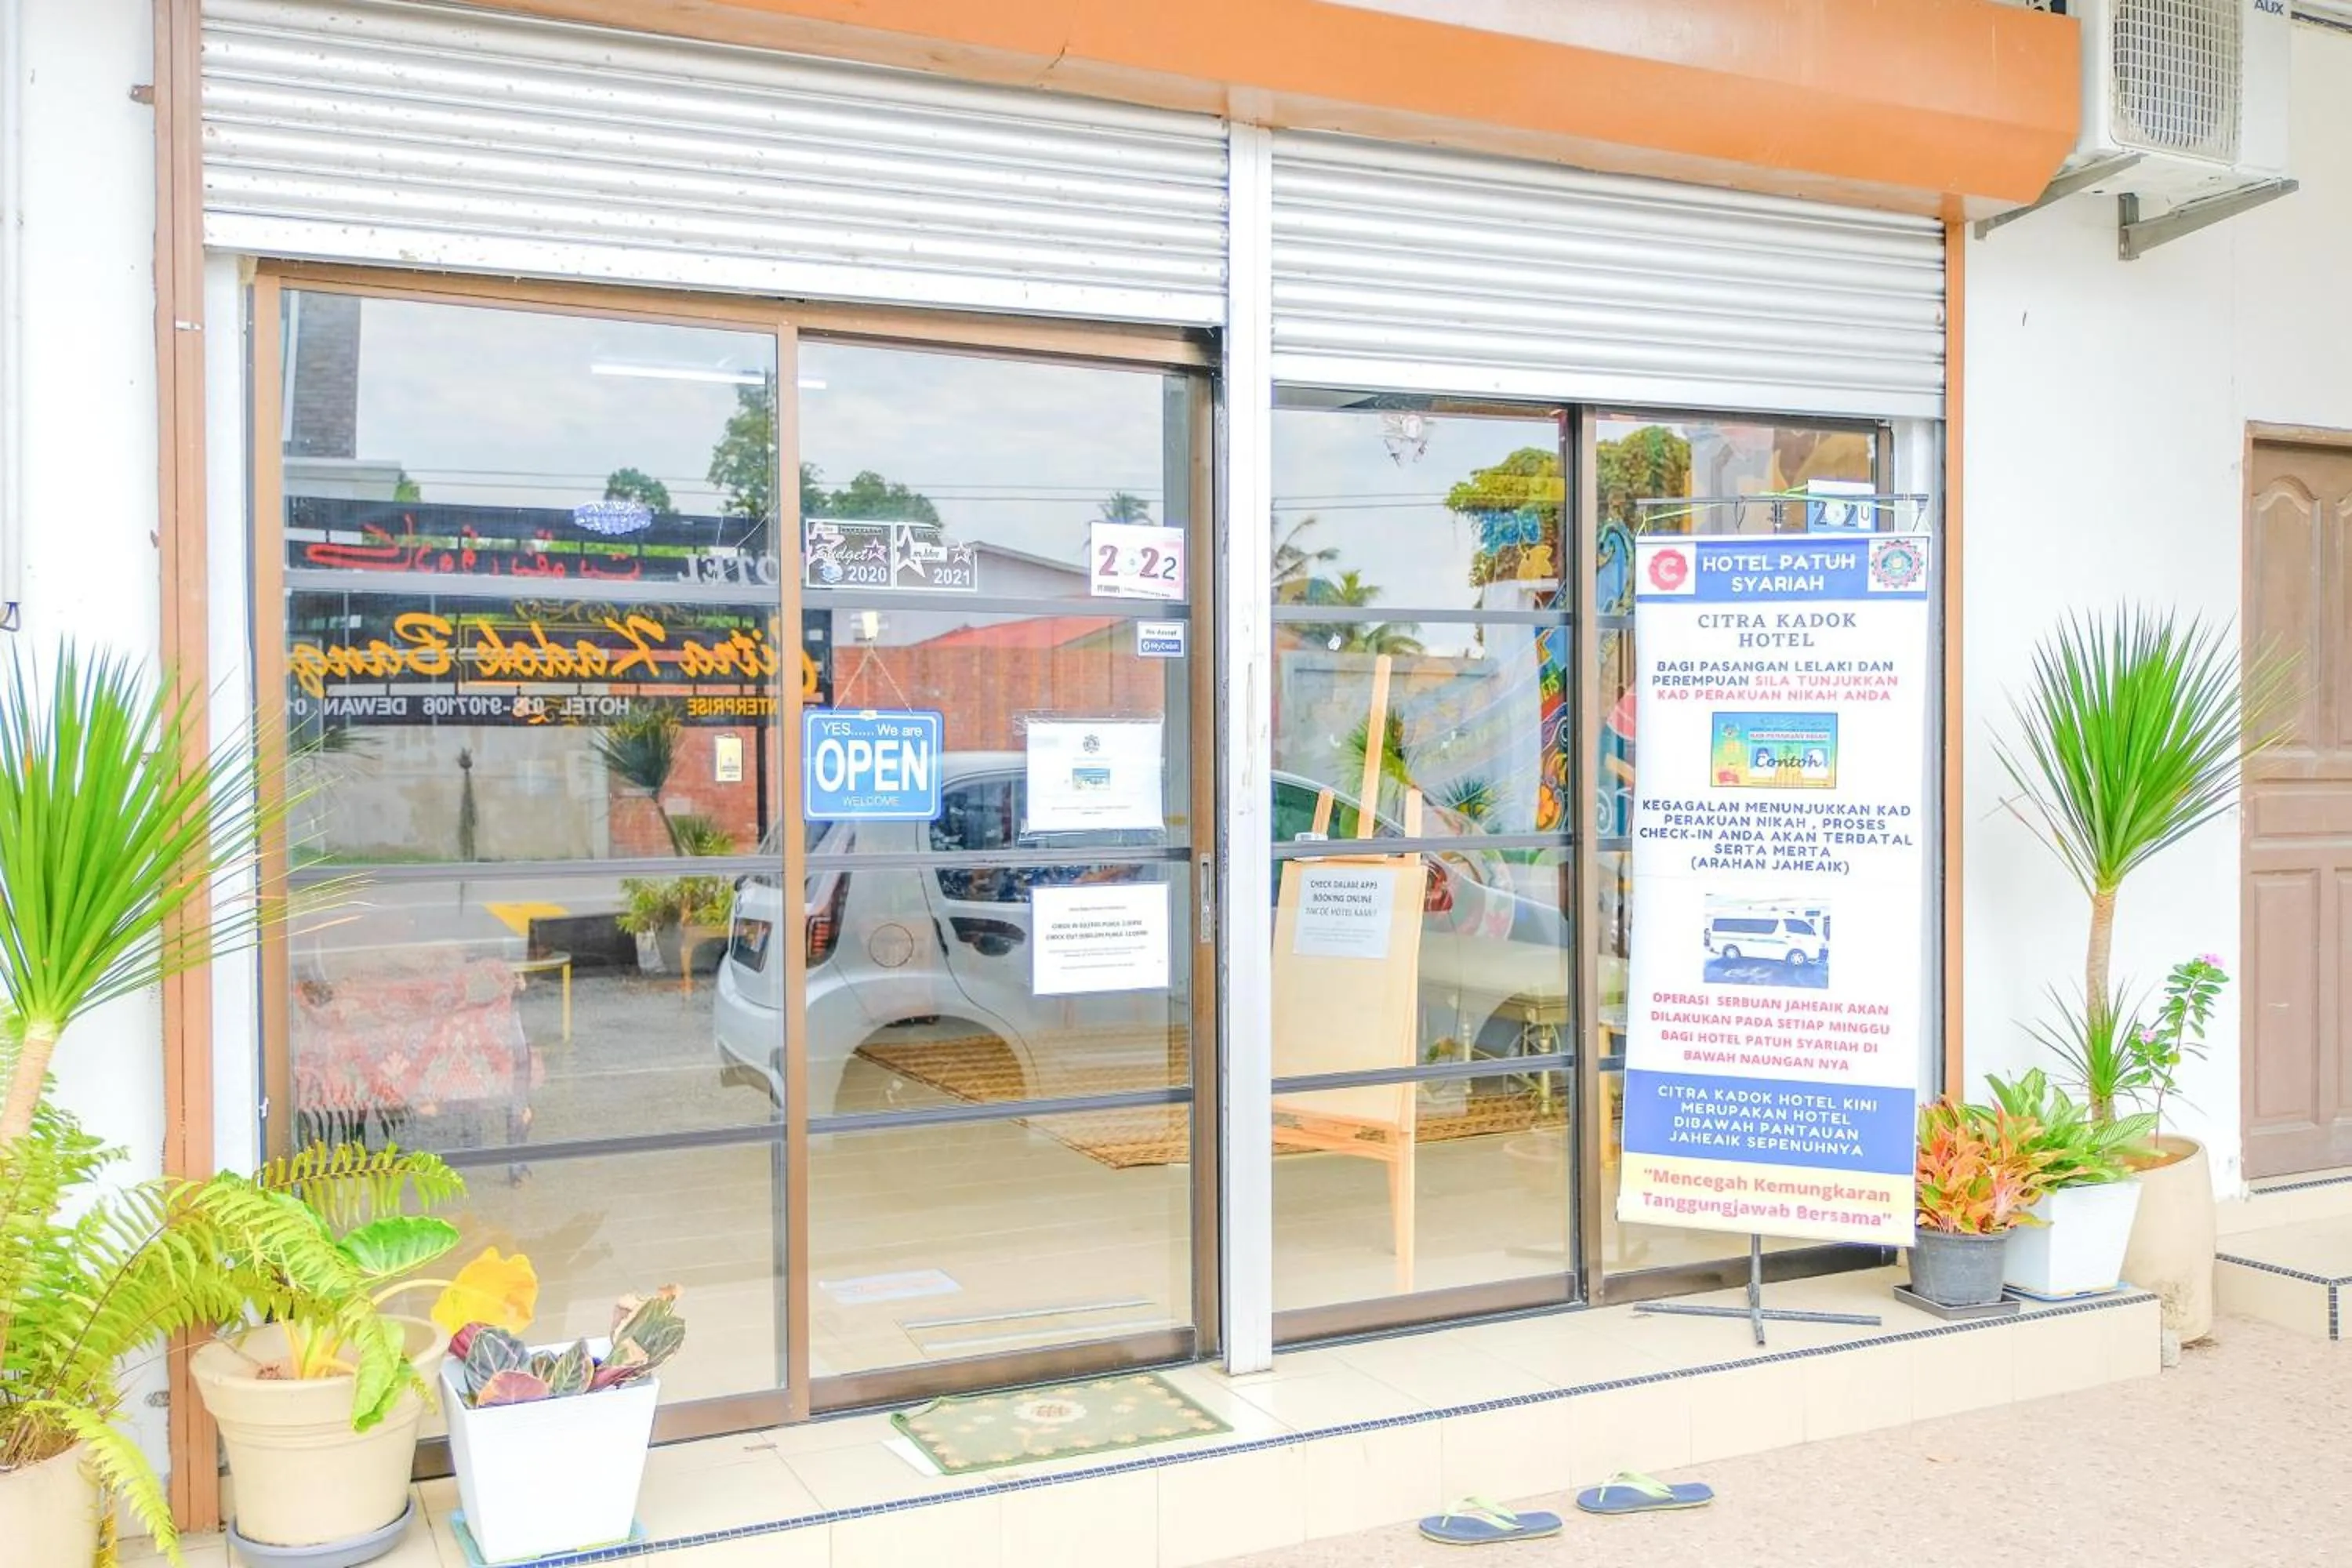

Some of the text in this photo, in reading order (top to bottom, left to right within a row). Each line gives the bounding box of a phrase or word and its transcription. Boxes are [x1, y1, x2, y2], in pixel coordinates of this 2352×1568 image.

[2253, 0, 2284, 15] AUX
[1701, 554, 1856, 572] HOTEL PATUH
[847, 565, 887, 583] 2020
[933, 568, 971, 585] 2021
[1731, 575, 1825, 593] SYARIAH
[1697, 612, 1857, 629] CITRA KADOK
[1738, 633, 1815, 648] HOTEL
[1656, 661, 1893, 673] BAGI PASANGAN LELAKI DAN
[1652, 675, 1899, 687] PEREMPUAN SILA TUNJUKKAN
[1657, 689, 1892, 701] KAD PERAKUAN NIKAH ANDA
[902, 726, 923, 736] are
[815, 738, 928, 793] OPEN
[1755, 753, 1822, 770] Contoh
[843, 795, 899, 807] WELCOME
[1642, 800, 1911, 817] KEGAGALAN MENUNJUKKAN KAD
[1664, 814, 1751, 827] PERAKUAN
[1756, 817, 1806, 828] NIKAH
[1822, 818, 1886, 831] PROSES
[1639, 827, 1913, 846] CHECK-IN ANDA AKAN TERBATAL
[1714, 844, 1831, 858] SERTA MERTA
[1691, 856, 1850, 875] (ARAHAN JAHEAIK)
[1652, 992, 1889, 1015] OPERASI SERBUAN JAHEAIK AKAN
[1650, 1011, 1890, 1035] DILAKUKAN PADA SETIAP MINGGU
[1661, 1029, 1878, 1053] BAGI HOTEL PATUH SYARIAH DI
[1683, 1050, 1849, 1071] BAWAH NAUNGAN NYA
[1657, 1085, 1878, 1112] CITRA KADOK HOTEL KINI
[1681, 1102, 1851, 1125] MERUPAKAN HOTEL
[1673, 1116, 1859, 1141] DIBAWAH PANTAUAN
[1668, 1131, 1864, 1156] JAHEAIK SEPENUHNYA
[1753, 1178, 1891, 1203] Kemungkaran
[1642, 1192, 1791, 1218] Tanggungjawab
